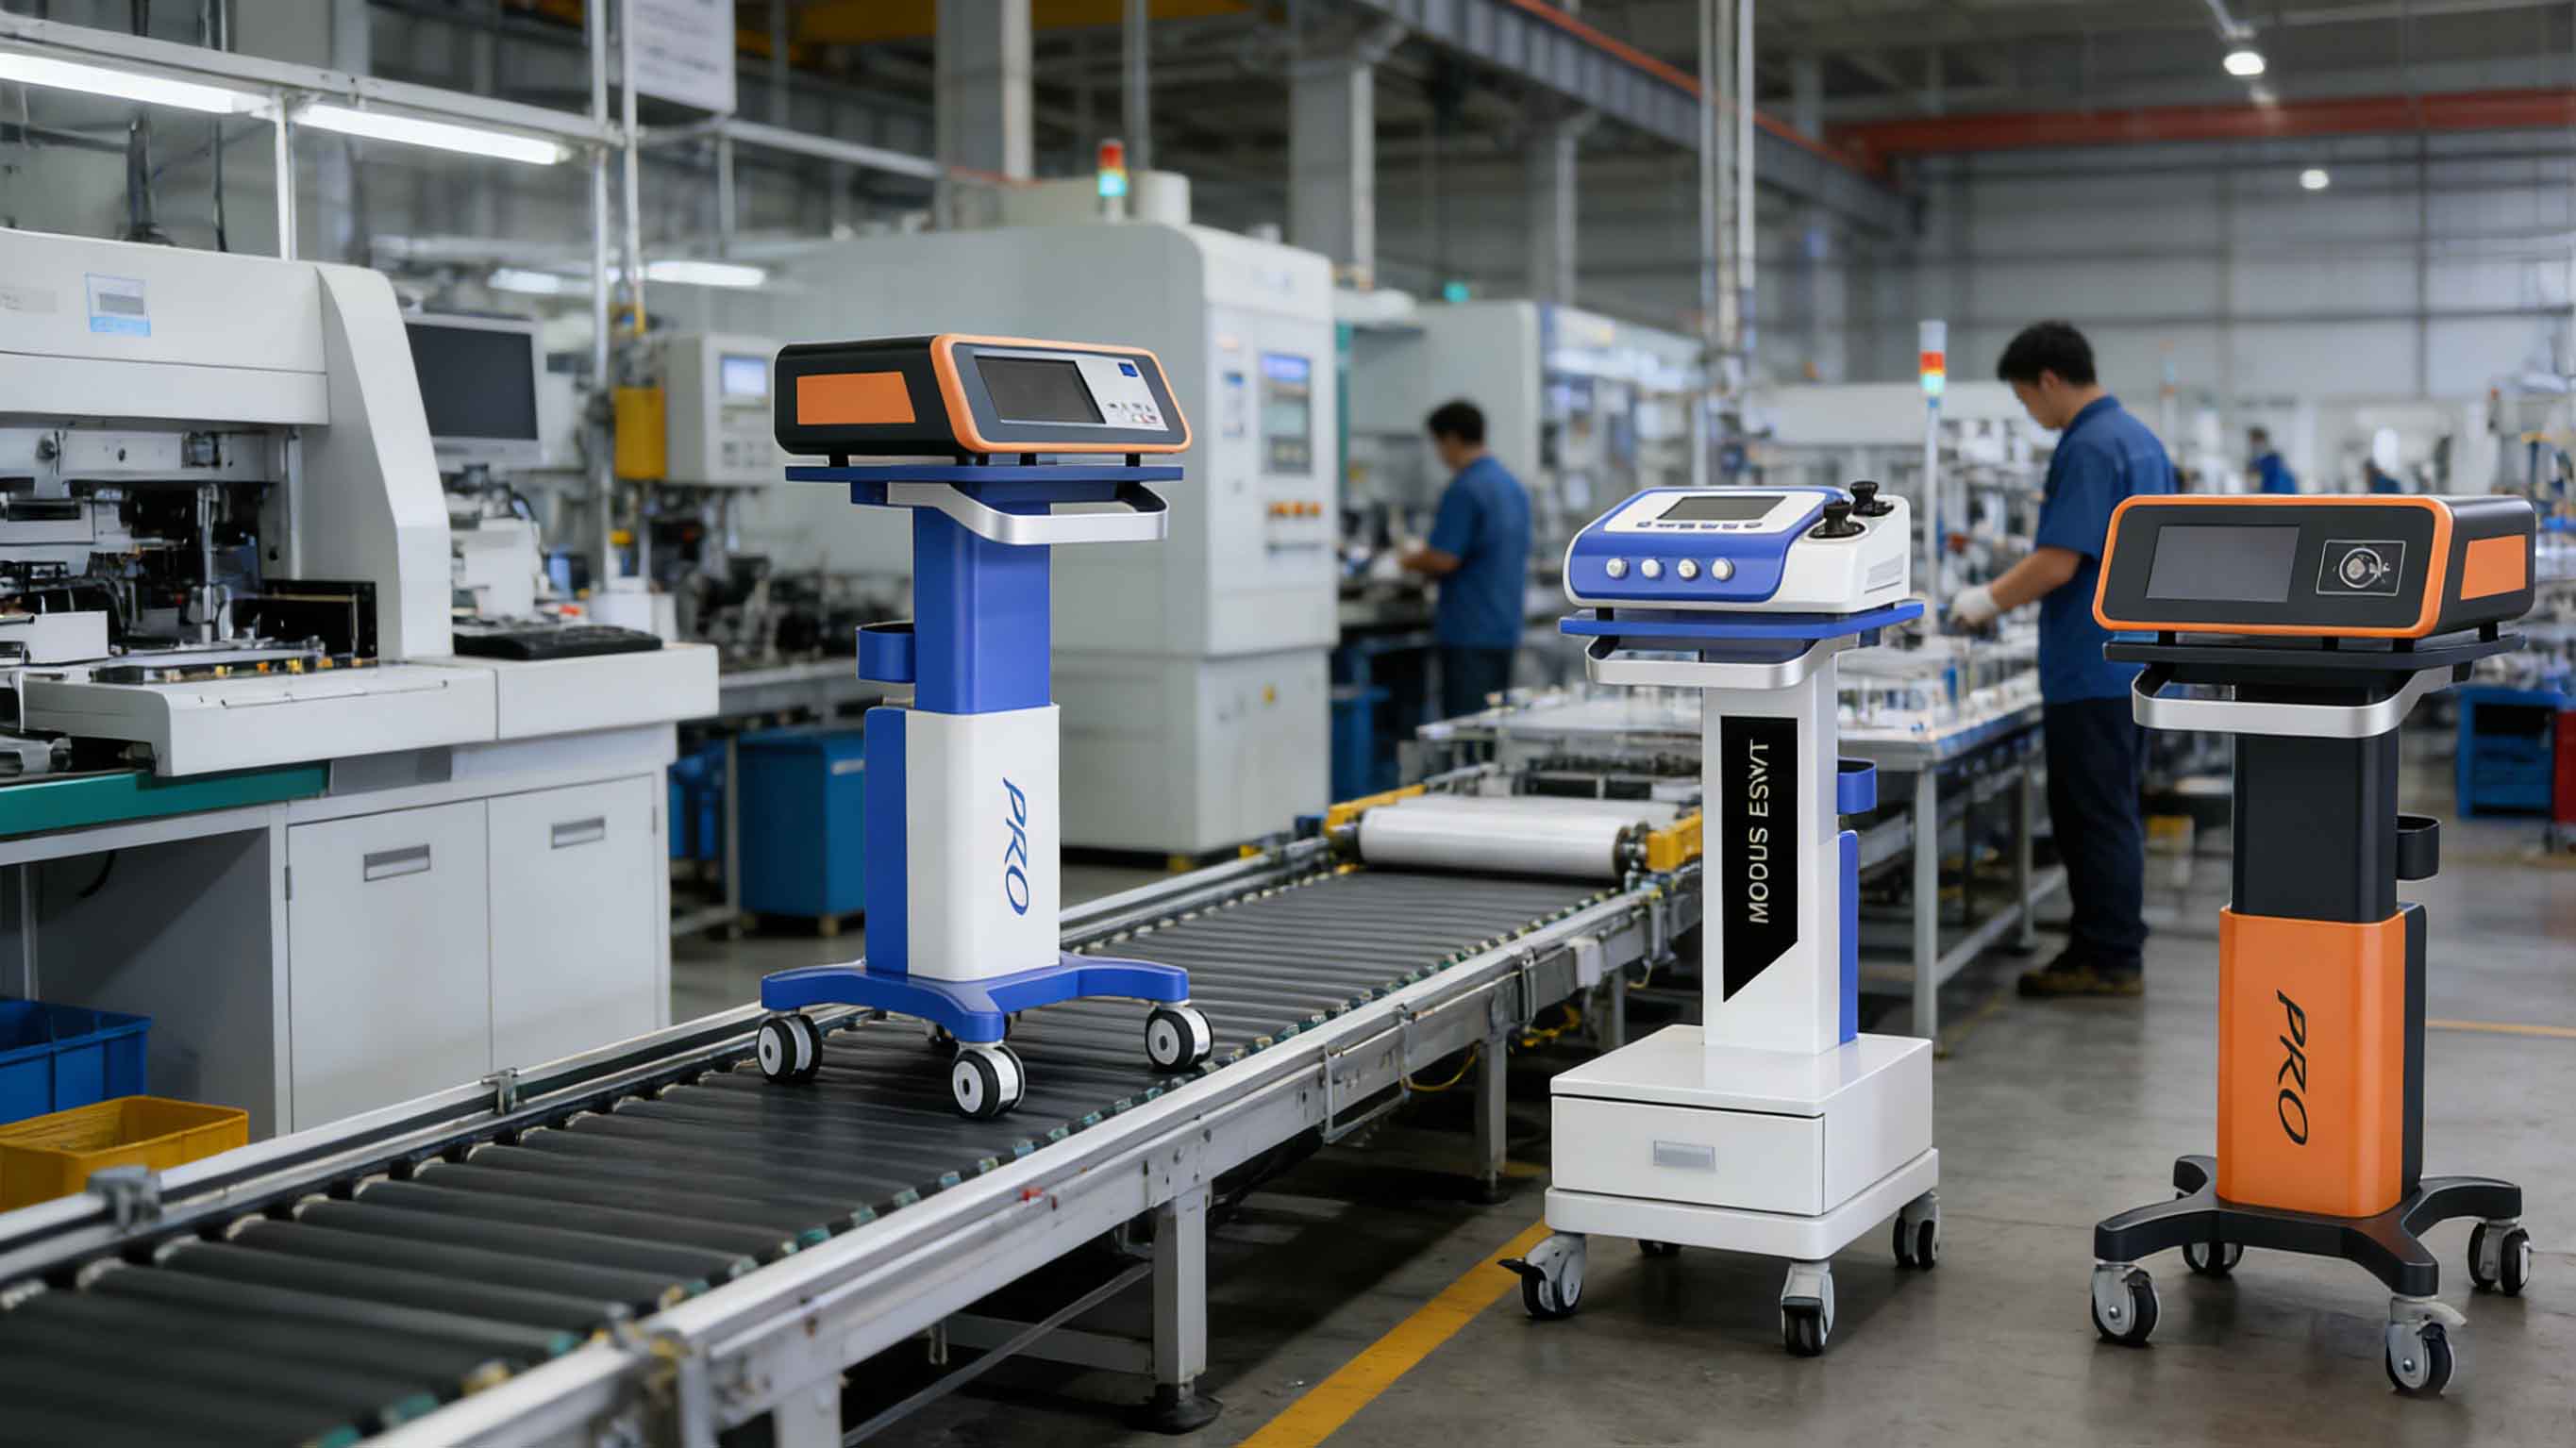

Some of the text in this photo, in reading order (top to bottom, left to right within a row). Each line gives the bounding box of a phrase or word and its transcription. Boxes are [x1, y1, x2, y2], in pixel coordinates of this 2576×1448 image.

[1002, 776, 1029, 916] PRO
[1748, 739, 1769, 924] MODUS ESWT
[2276, 988, 2309, 1146] PRO
